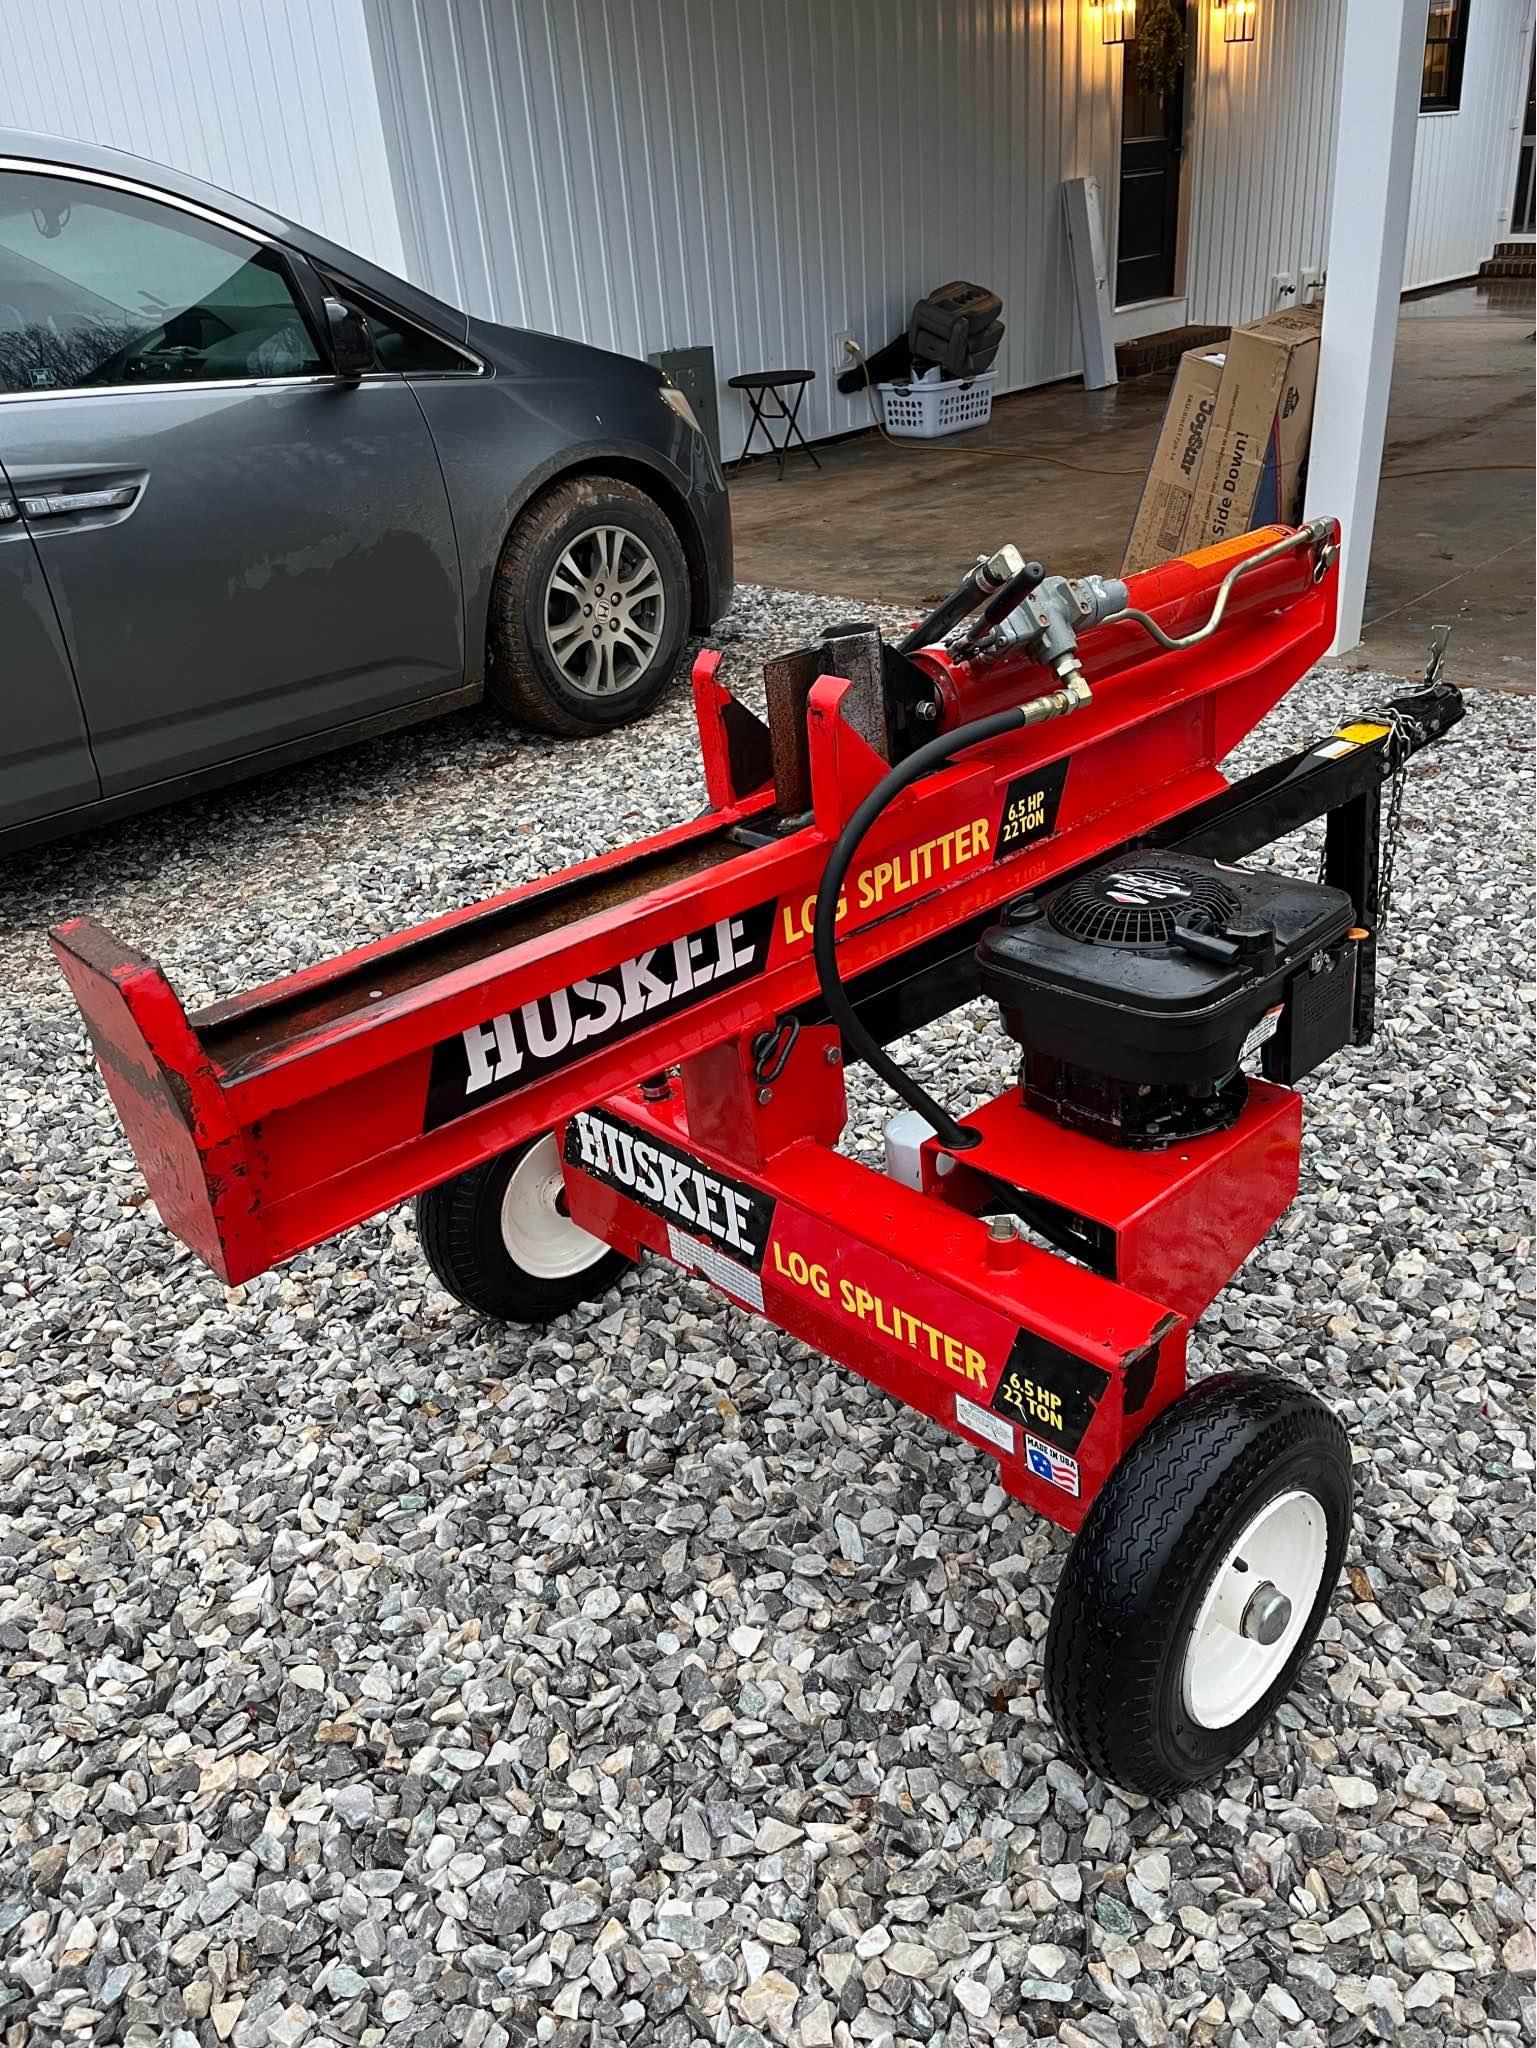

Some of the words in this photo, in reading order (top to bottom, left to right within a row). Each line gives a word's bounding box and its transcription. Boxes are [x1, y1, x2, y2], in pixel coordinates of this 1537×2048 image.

[1212, 495, 1232, 537] Side
[1223, 431, 1249, 491] Down!
[1003, 821, 1019, 842] 22
[1019, 808, 1045, 833] TON
[1008, 799, 1026, 822] 6.5
[1027, 791, 1045, 813] HP
[857, 818, 991, 910] SPLITTER
[462, 917, 756, 1096] HUSKEE
[574, 1111, 756, 1256] HUSKEE
[772, 1240, 831, 1299] LOG
[839, 1279, 988, 1389] SPLITTER
[1002, 1384, 1022, 1407] 22
[1026, 1396, 1063, 1431] TON
[1009, 1372, 1034, 1397] 6.5
[1037, 1385, 1062, 1410] HP
[1027, 1436, 1049, 1455] MADE
[1049, 1448, 1059, 1460] IN
[1059, 1454, 1076, 1470] USA
